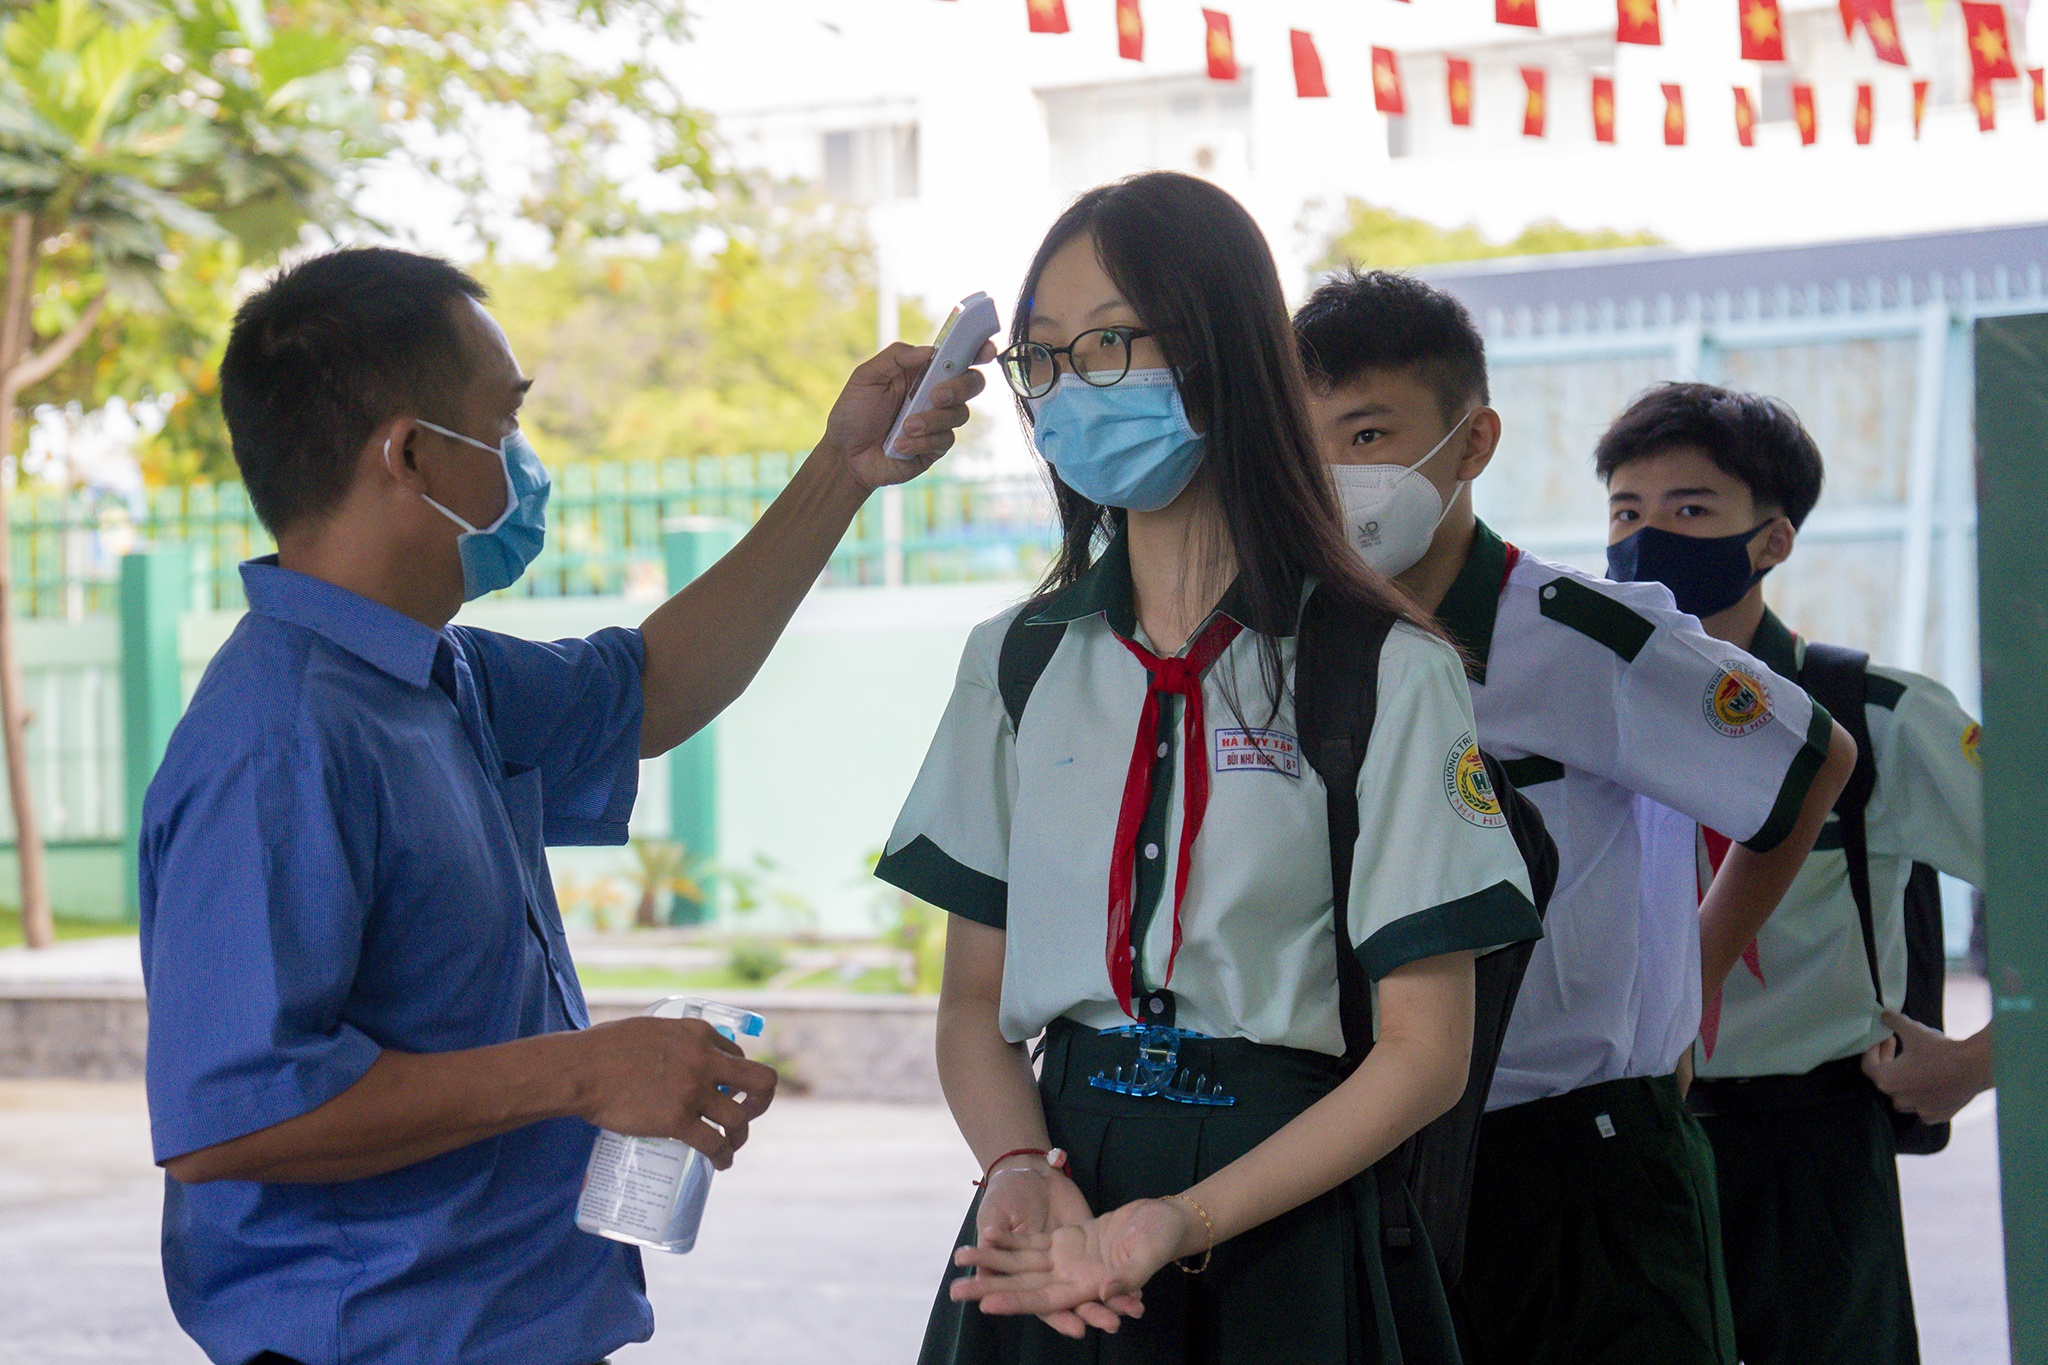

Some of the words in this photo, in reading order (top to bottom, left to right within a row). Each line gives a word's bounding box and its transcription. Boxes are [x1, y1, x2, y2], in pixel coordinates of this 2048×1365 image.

[1222, 736, 1239, 747] HÀ
[1243, 737, 1269, 747] HUY
[1273, 739, 1293, 752] TẬP
[1227, 752, 1239, 765] BÙI
[1240, 752, 1255, 765] NHƯ
